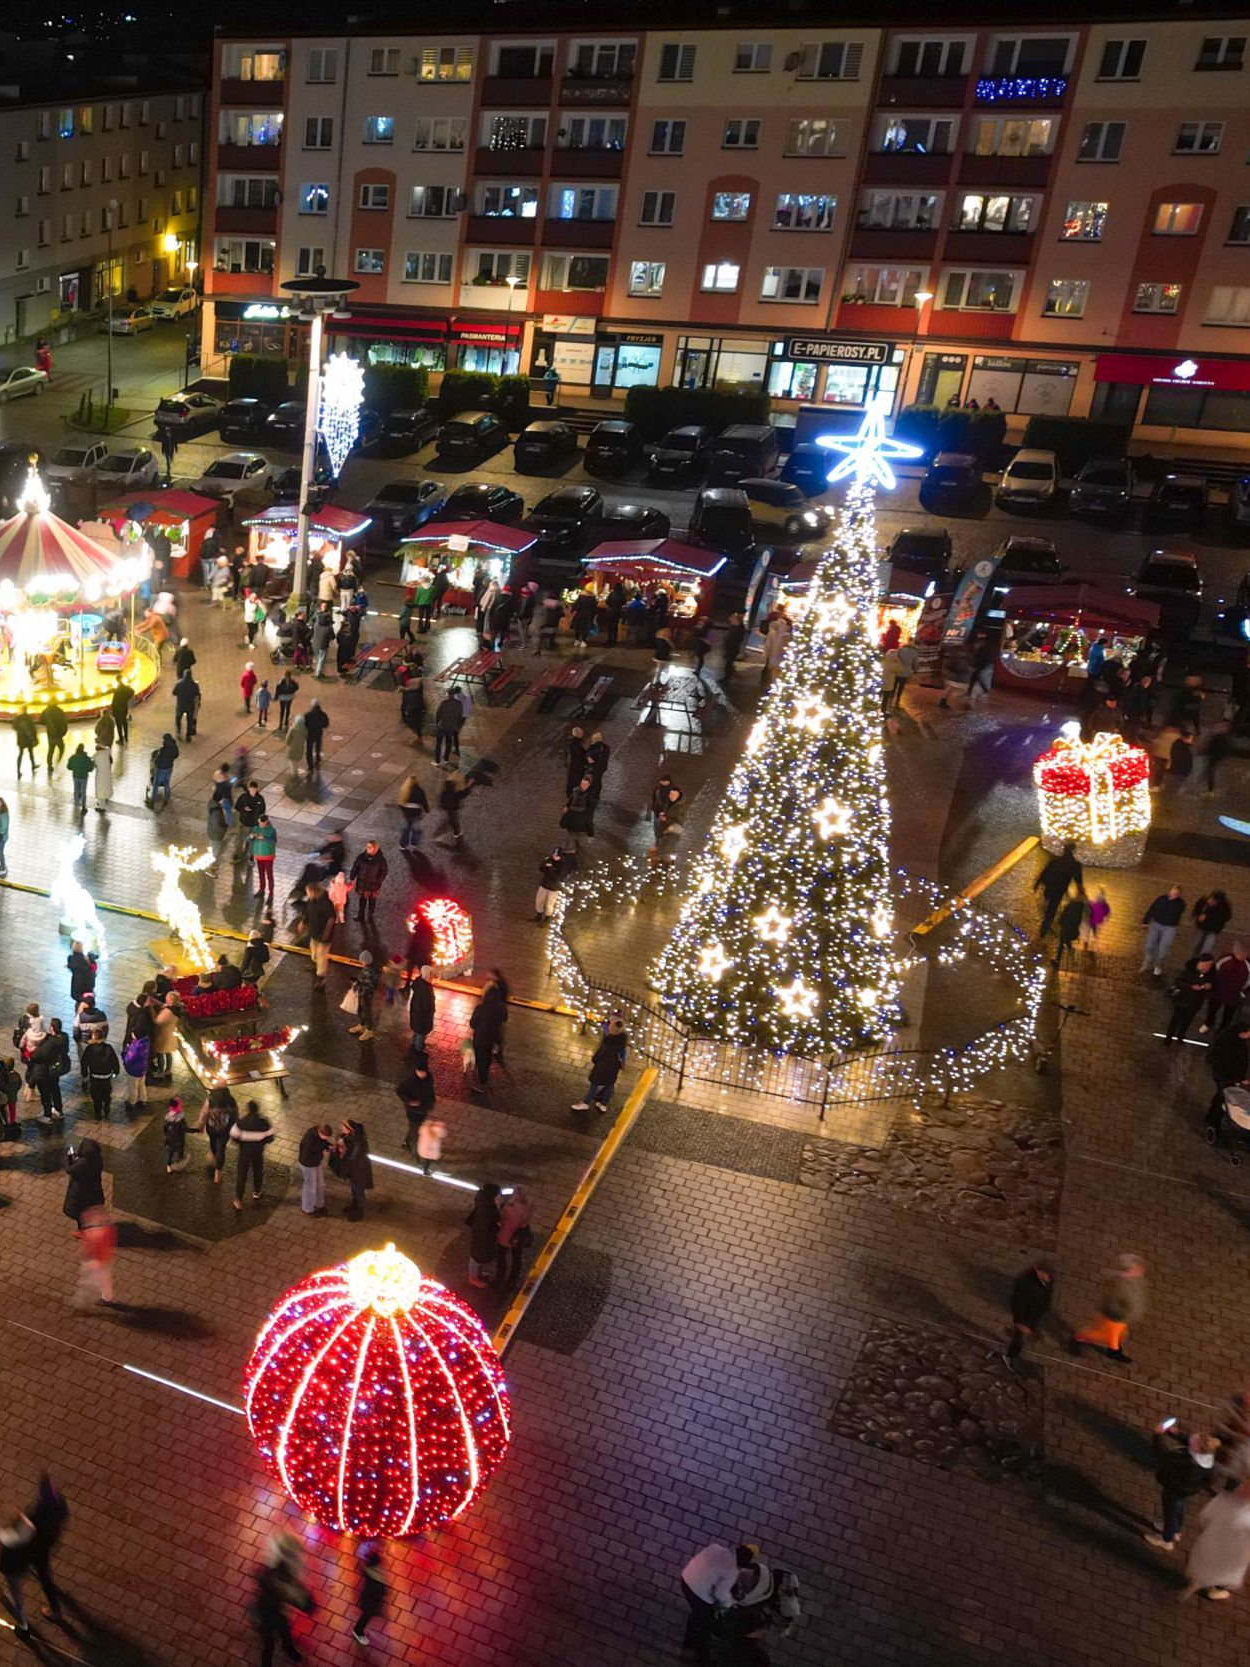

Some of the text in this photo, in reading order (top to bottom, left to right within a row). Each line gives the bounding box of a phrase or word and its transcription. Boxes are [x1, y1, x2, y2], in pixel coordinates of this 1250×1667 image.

[461, 332, 506, 341] PASMANTERIA
[627, 335, 657, 343] FRYZJER
[793, 342, 882, 360] E-PAPIEROSY.PL
